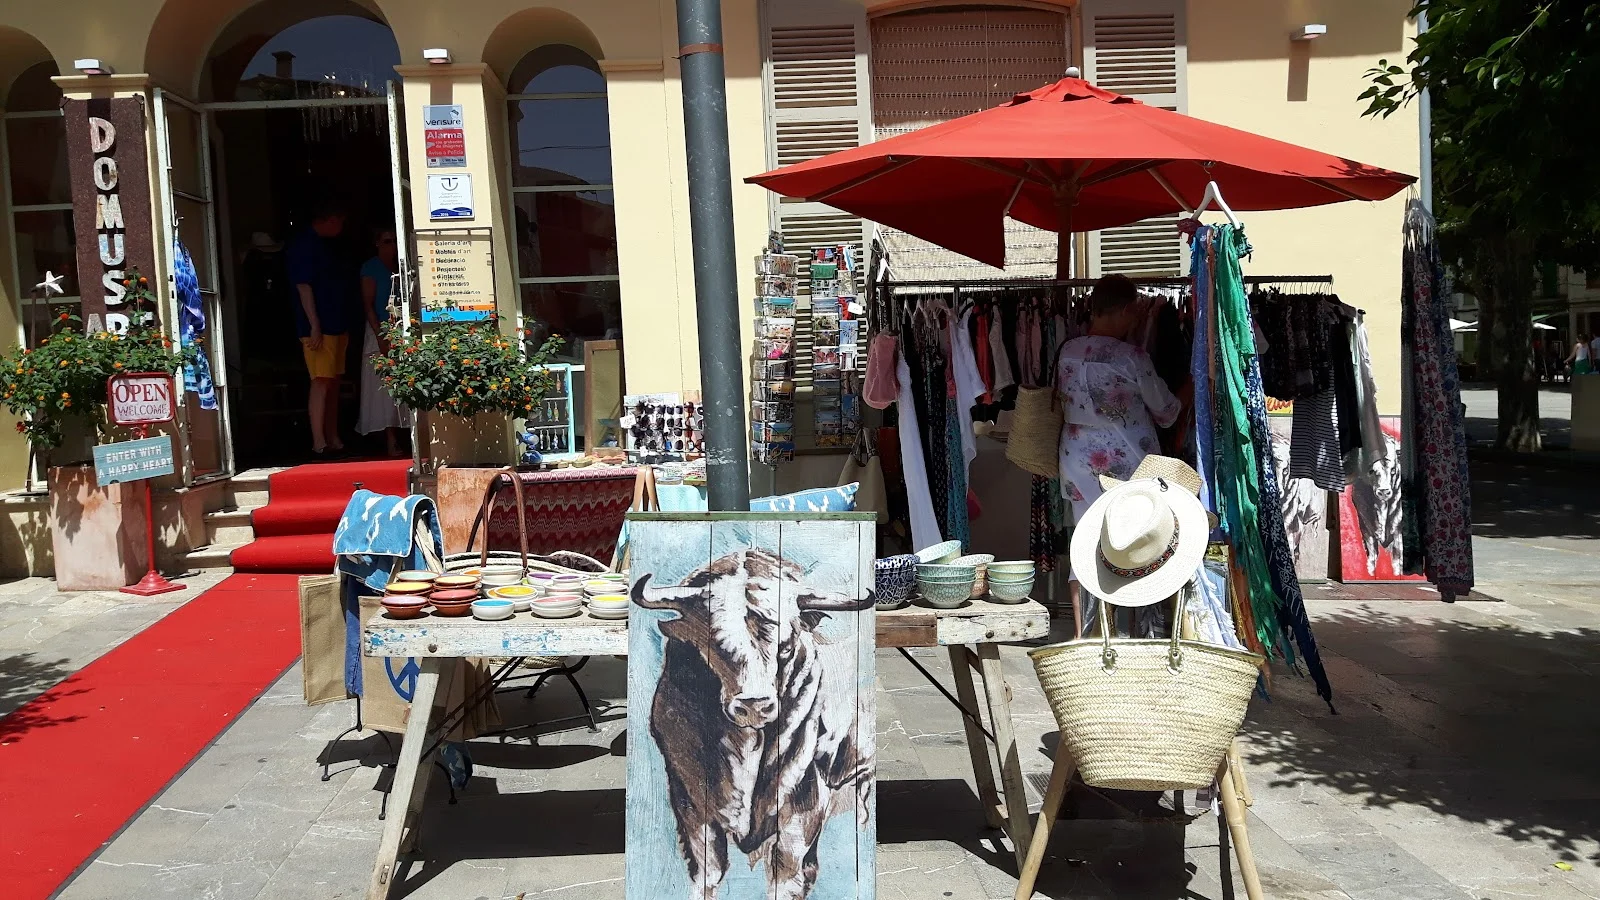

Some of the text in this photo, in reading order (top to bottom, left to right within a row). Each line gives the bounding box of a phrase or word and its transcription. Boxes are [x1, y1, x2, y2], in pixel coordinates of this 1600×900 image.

[427, 131, 463, 139] Alarma
[88, 116, 127, 306] DOMUS
[115, 383, 168, 403] OPEN
[117, 403, 168, 417] WELCOME
[106, 445, 162, 464] ENTER WITH
[98, 457, 173, 479] A HAPPY HEART
